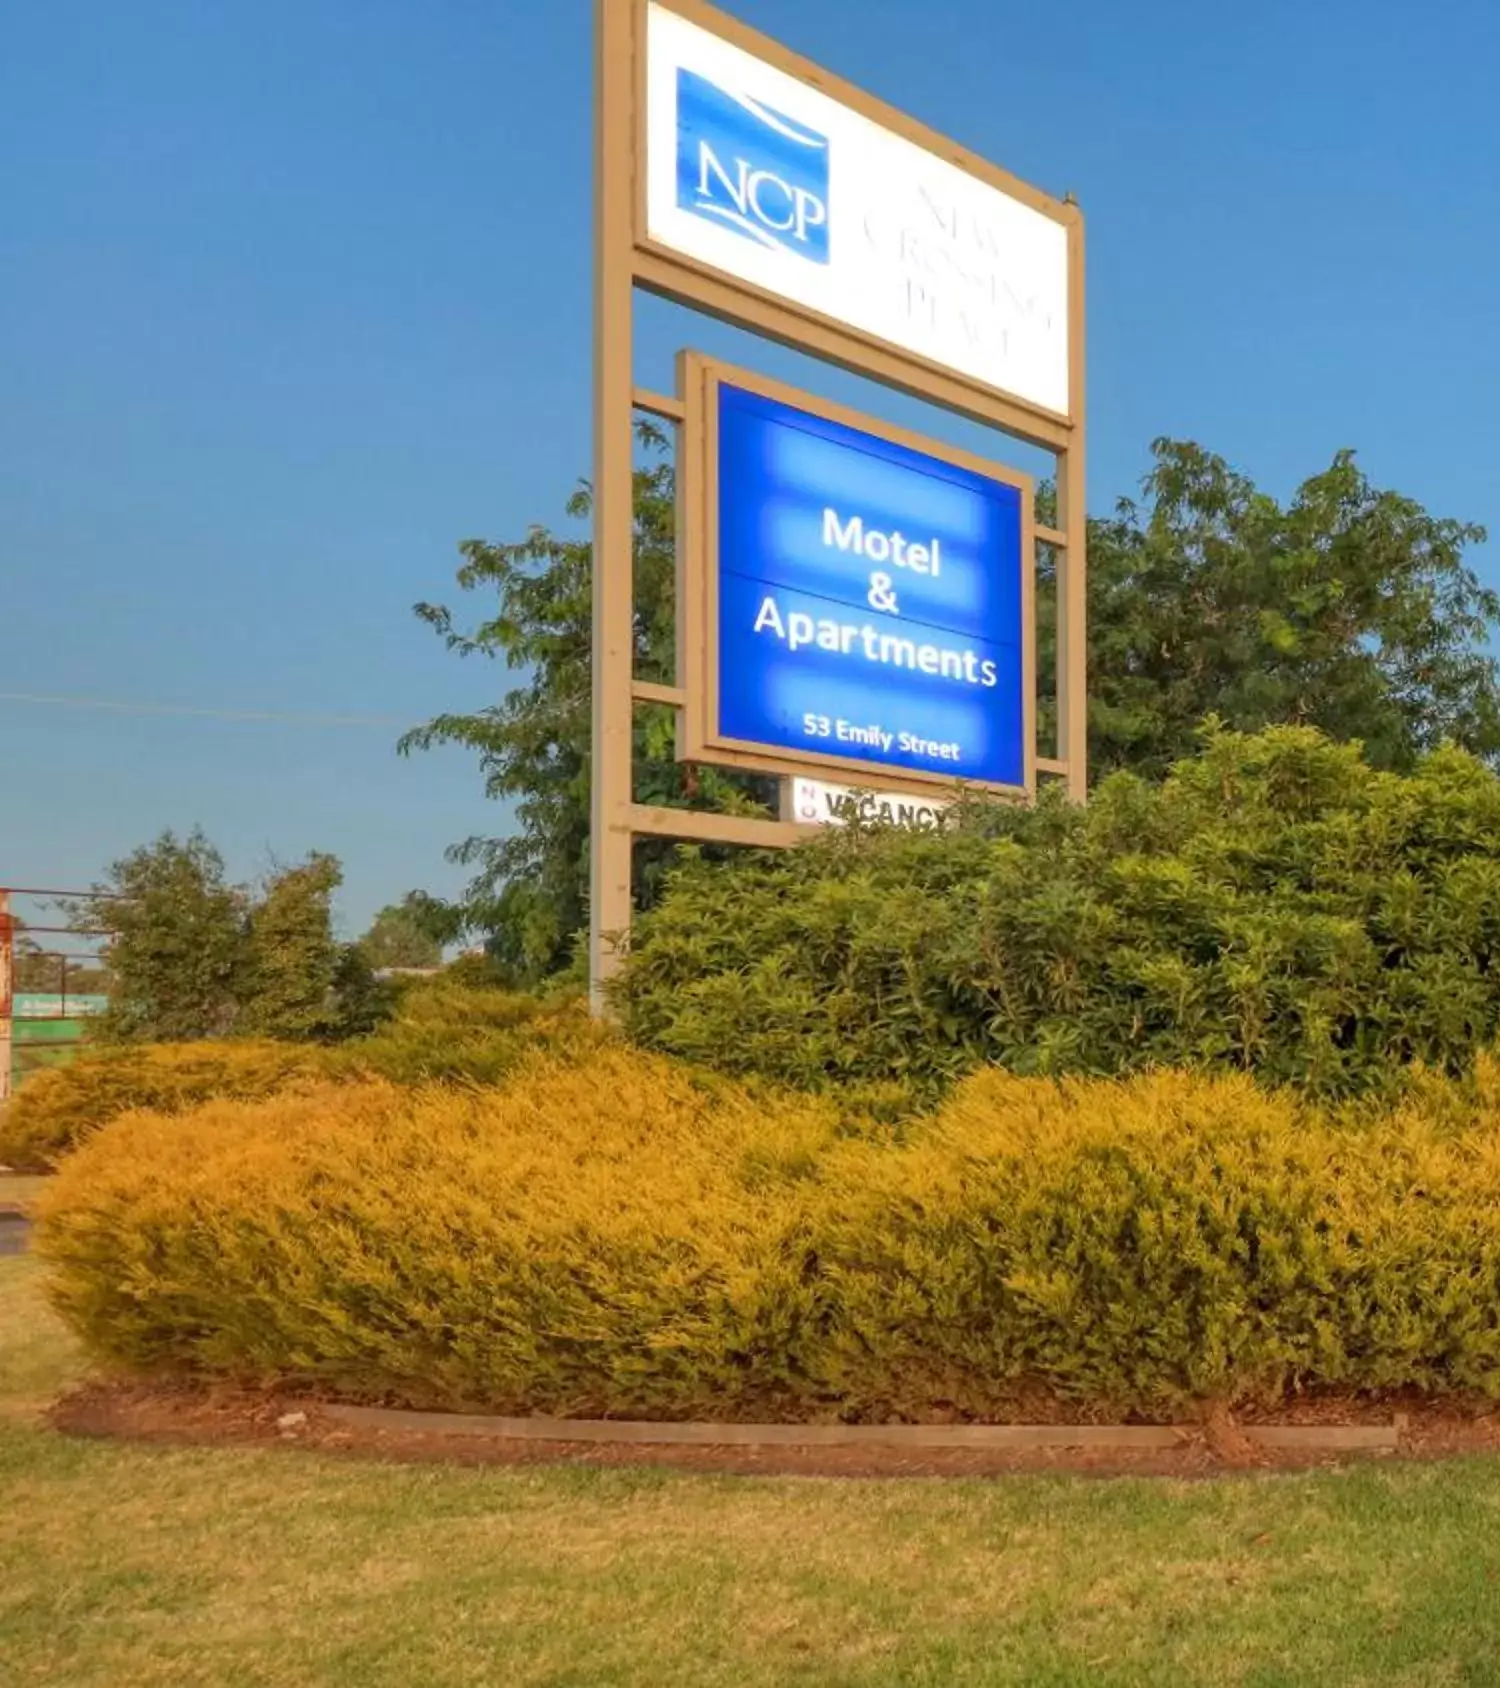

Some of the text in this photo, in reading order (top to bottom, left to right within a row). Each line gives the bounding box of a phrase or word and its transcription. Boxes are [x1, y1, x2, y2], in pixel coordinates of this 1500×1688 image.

[695, 140, 825, 241] NCP
[823, 507, 940, 577] Motel
[867, 571, 899, 614] &
[754, 596, 998, 688] Apartments
[803, 713, 960, 760] 53 Emily Street
